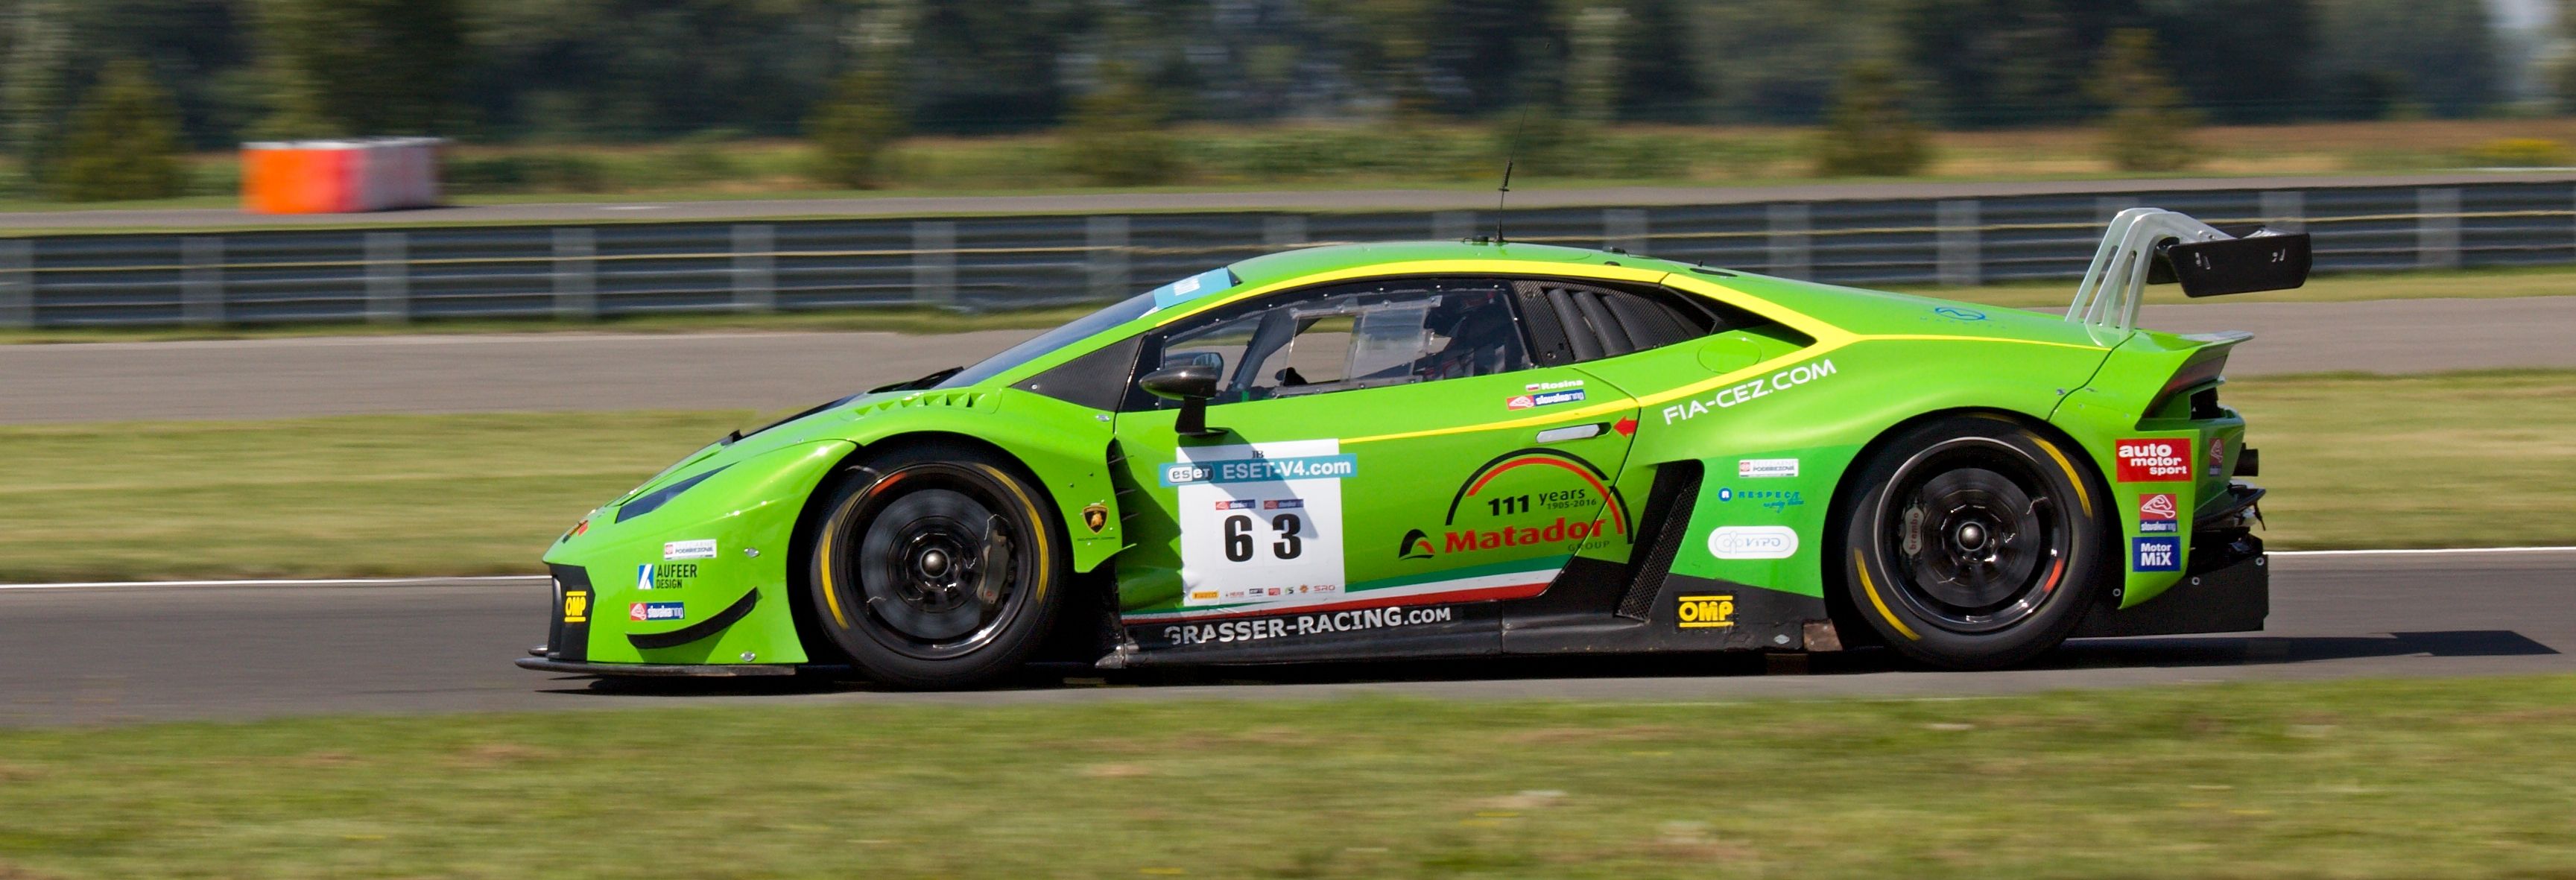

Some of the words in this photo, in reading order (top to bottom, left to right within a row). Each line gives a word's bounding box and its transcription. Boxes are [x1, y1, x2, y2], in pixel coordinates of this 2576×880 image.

[1541, 379, 1584, 390] Rosina
[1662, 358, 1837, 425] FIA-CEZ.COM
[2118, 443, 2172, 458] auto
[2130, 456, 2182, 466] motor
[1223, 460, 1351, 480] ESET-V4.com
[2149, 466, 2187, 476] sport
[1487, 495, 1530, 516] 111
[1539, 488, 1586, 506] years
[1547, 498, 1597, 510] 1905-2016
[1445, 517, 1607, 554] Matador
[1909, 512, 1920, 550] brembo
[2140, 542, 2172, 552] Motor
[2141, 552, 2172, 566] MiX
[656, 564, 697, 578] AUFEER
[656, 579, 683, 589] DESIGN
[1314, 584, 1335, 592] SRO
[565, 597, 586, 615] OMP
[1679, 601, 1734, 621] OMP
[1164, 607, 1452, 645] GRASSER-RACING.COM
